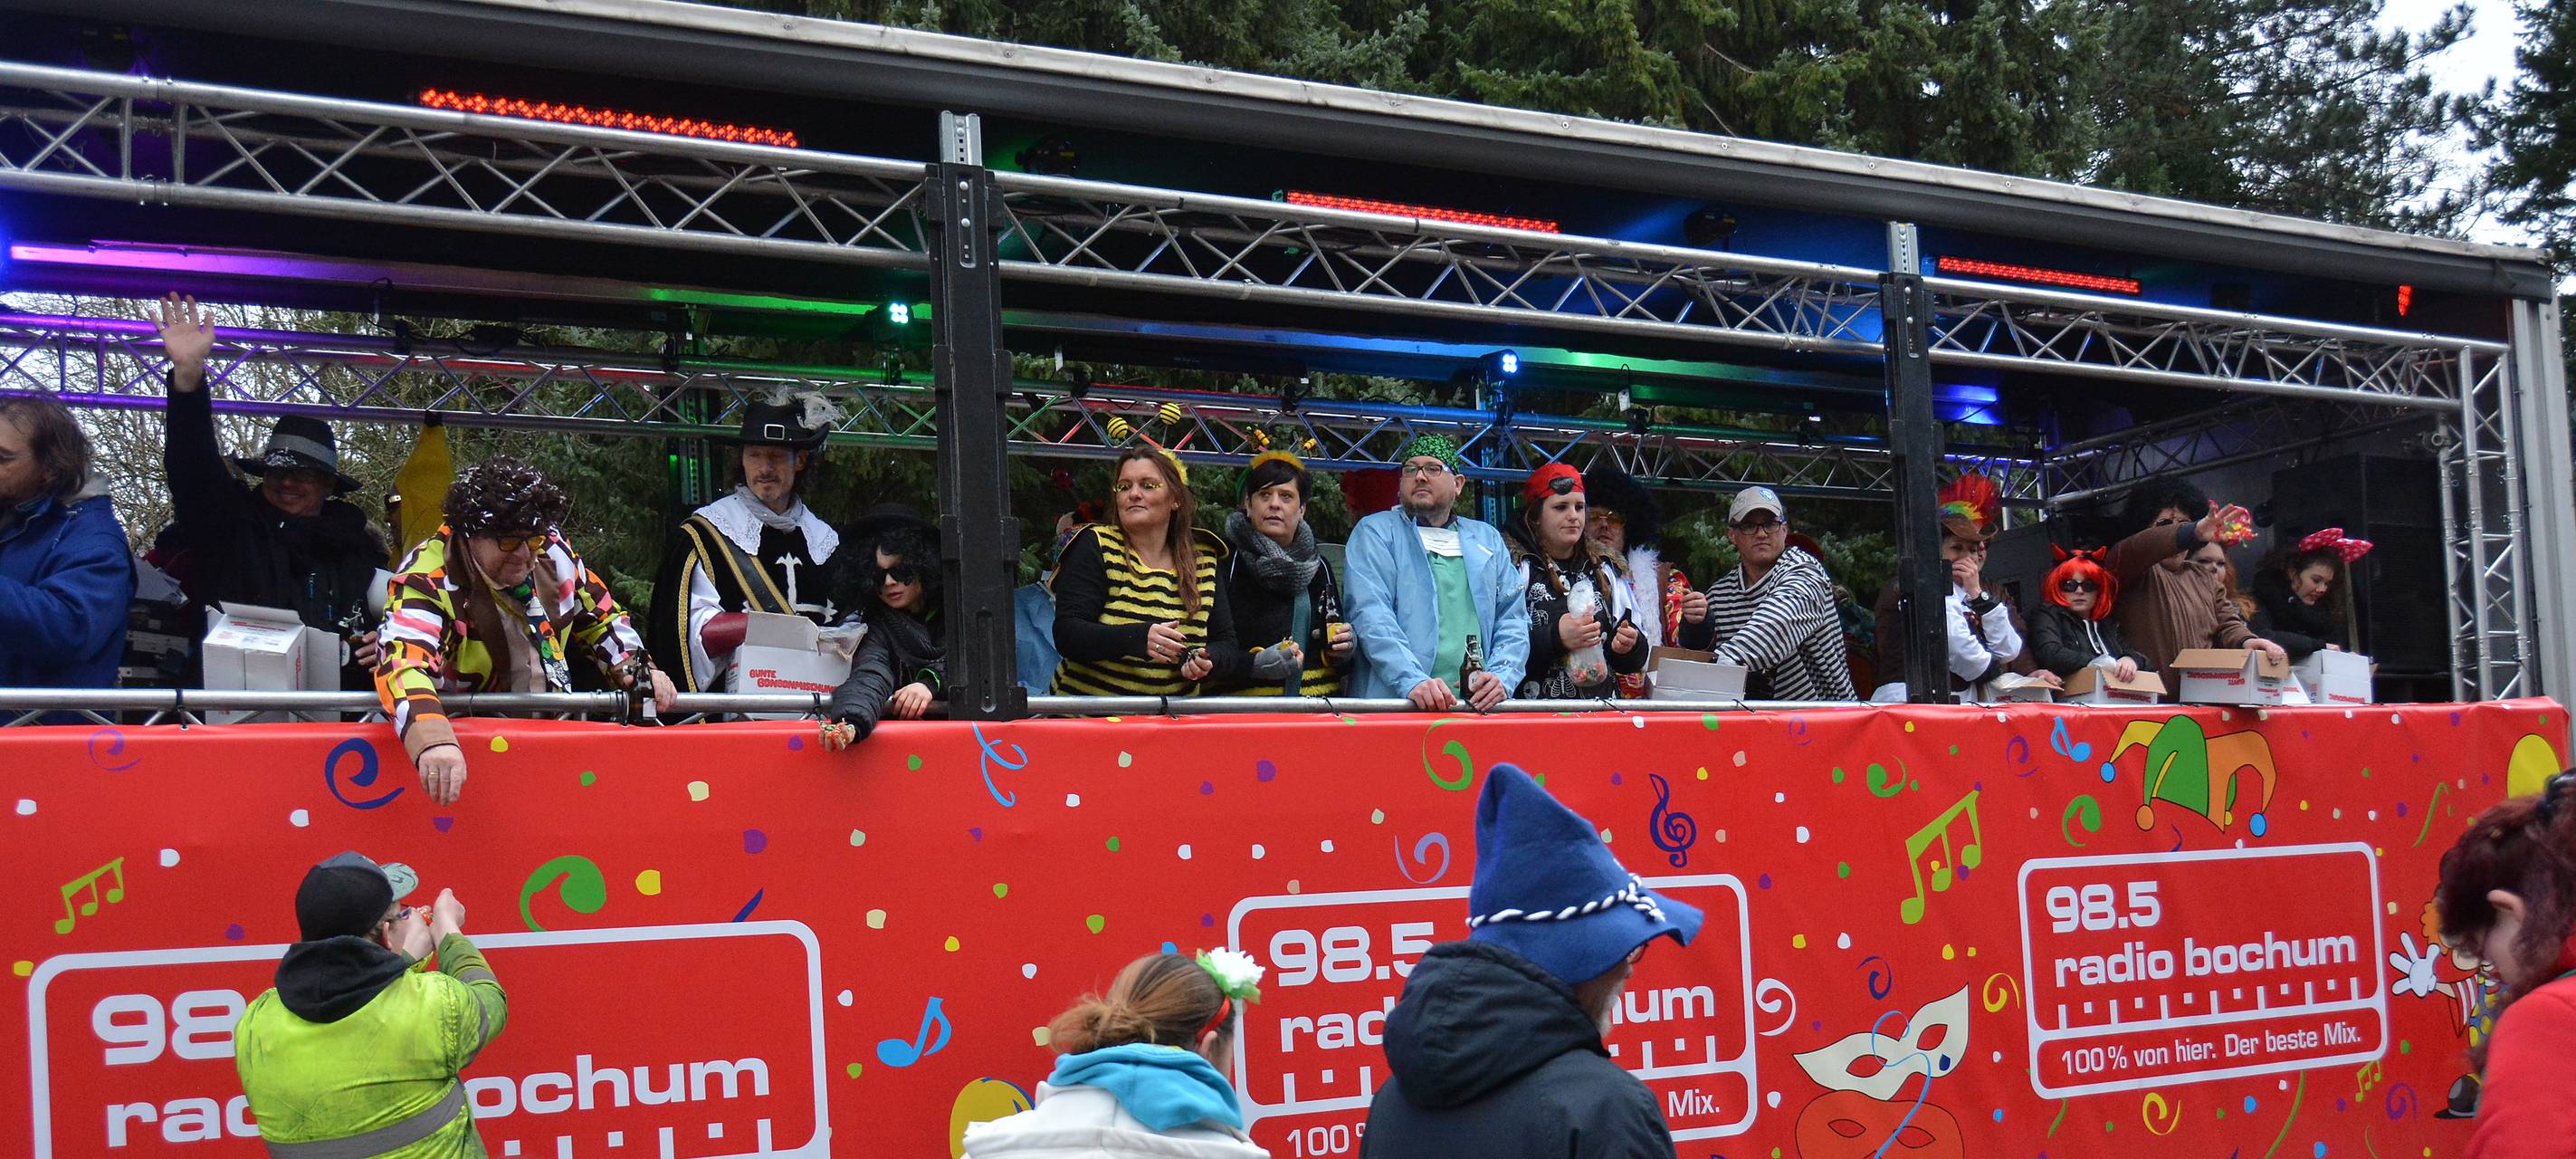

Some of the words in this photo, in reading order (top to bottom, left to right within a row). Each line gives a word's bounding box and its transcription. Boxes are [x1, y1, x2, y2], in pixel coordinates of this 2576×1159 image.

[2046, 880, 2161, 934] 98.5
[1269, 921, 1435, 987] 98.5
[2055, 942, 2174, 988] radio
[2184, 931, 2356, 977] bochum
[92, 989, 248, 1066] 98
[1280, 996, 1396, 1053] rad
[2133, 1047, 2169, 1067] von
[2174, 1038, 2217, 1063] hier.
[2224, 1033, 2259, 1058] Der
[2265, 1029, 2318, 1053] beste
[2323, 1021, 2361, 1046] Mix.
[463, 1054, 770, 1119] ochum
[1668, 1088, 1720, 1117] Mix.
